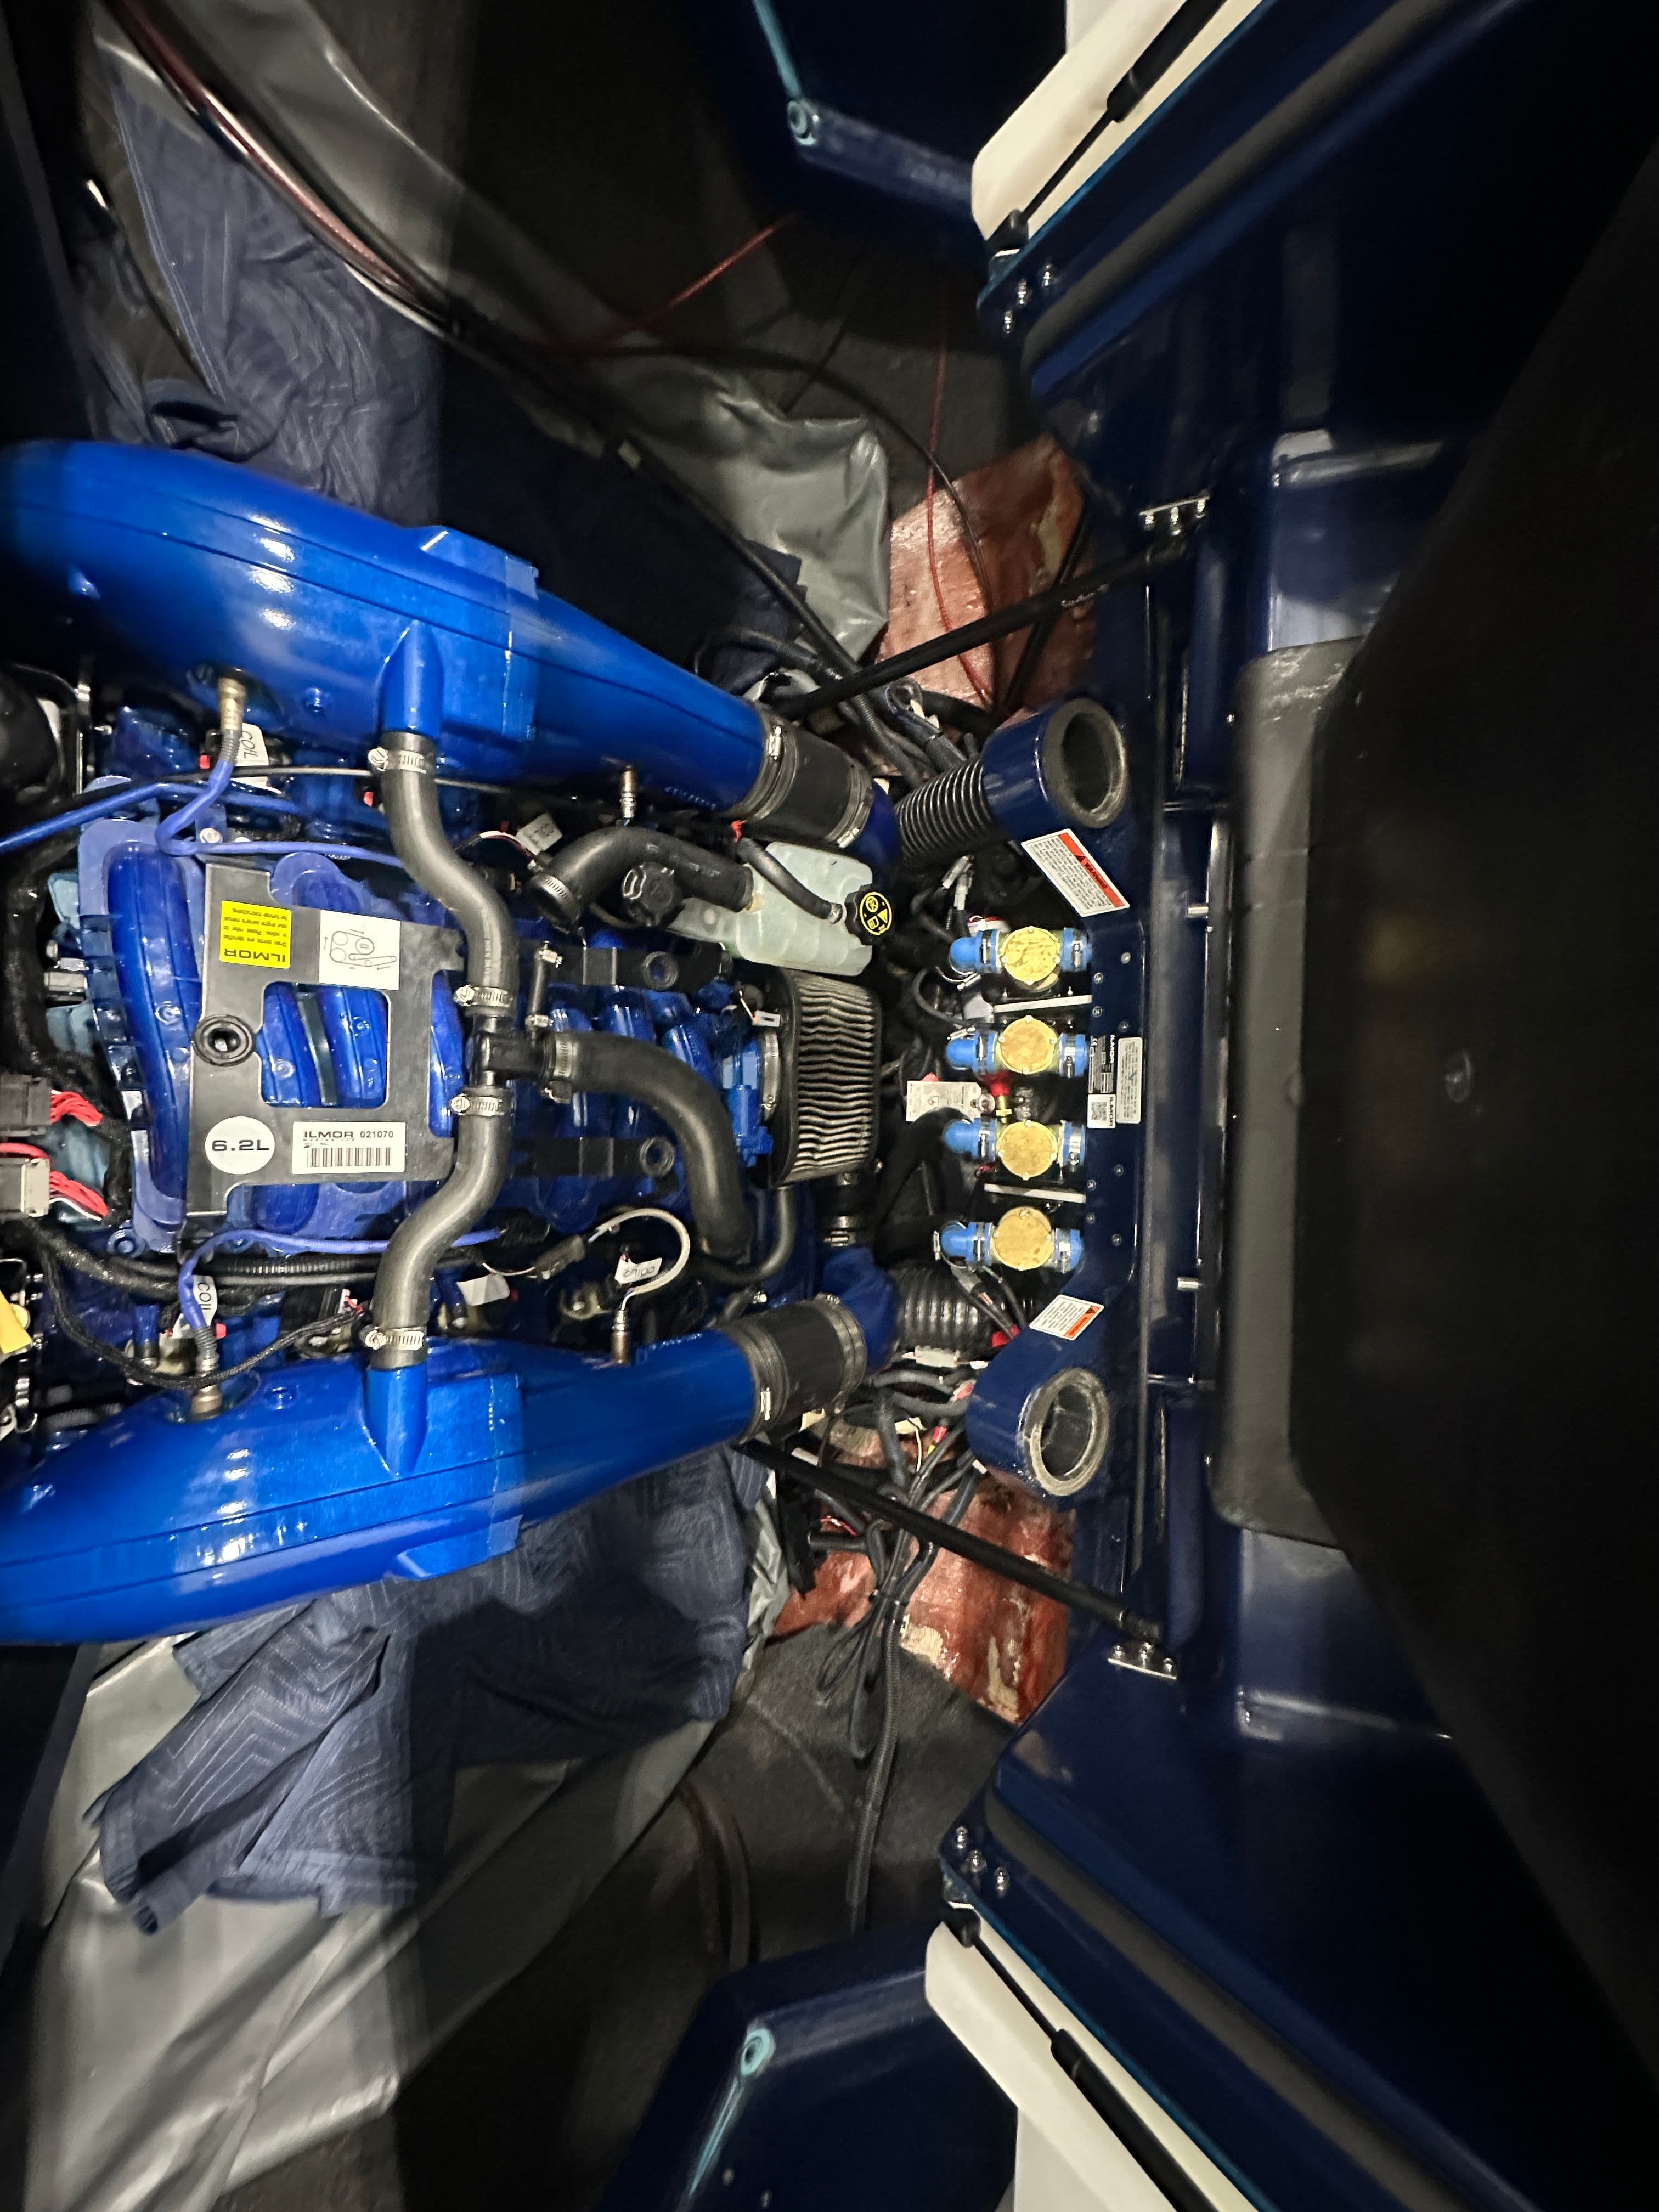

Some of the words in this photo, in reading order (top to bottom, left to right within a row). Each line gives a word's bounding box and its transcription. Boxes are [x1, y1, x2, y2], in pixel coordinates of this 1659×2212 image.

[1085, 862, 1107, 889] WARNING
[224, 948, 285, 962] ILMOR
[211, 1139, 270, 1152] 6.2L
